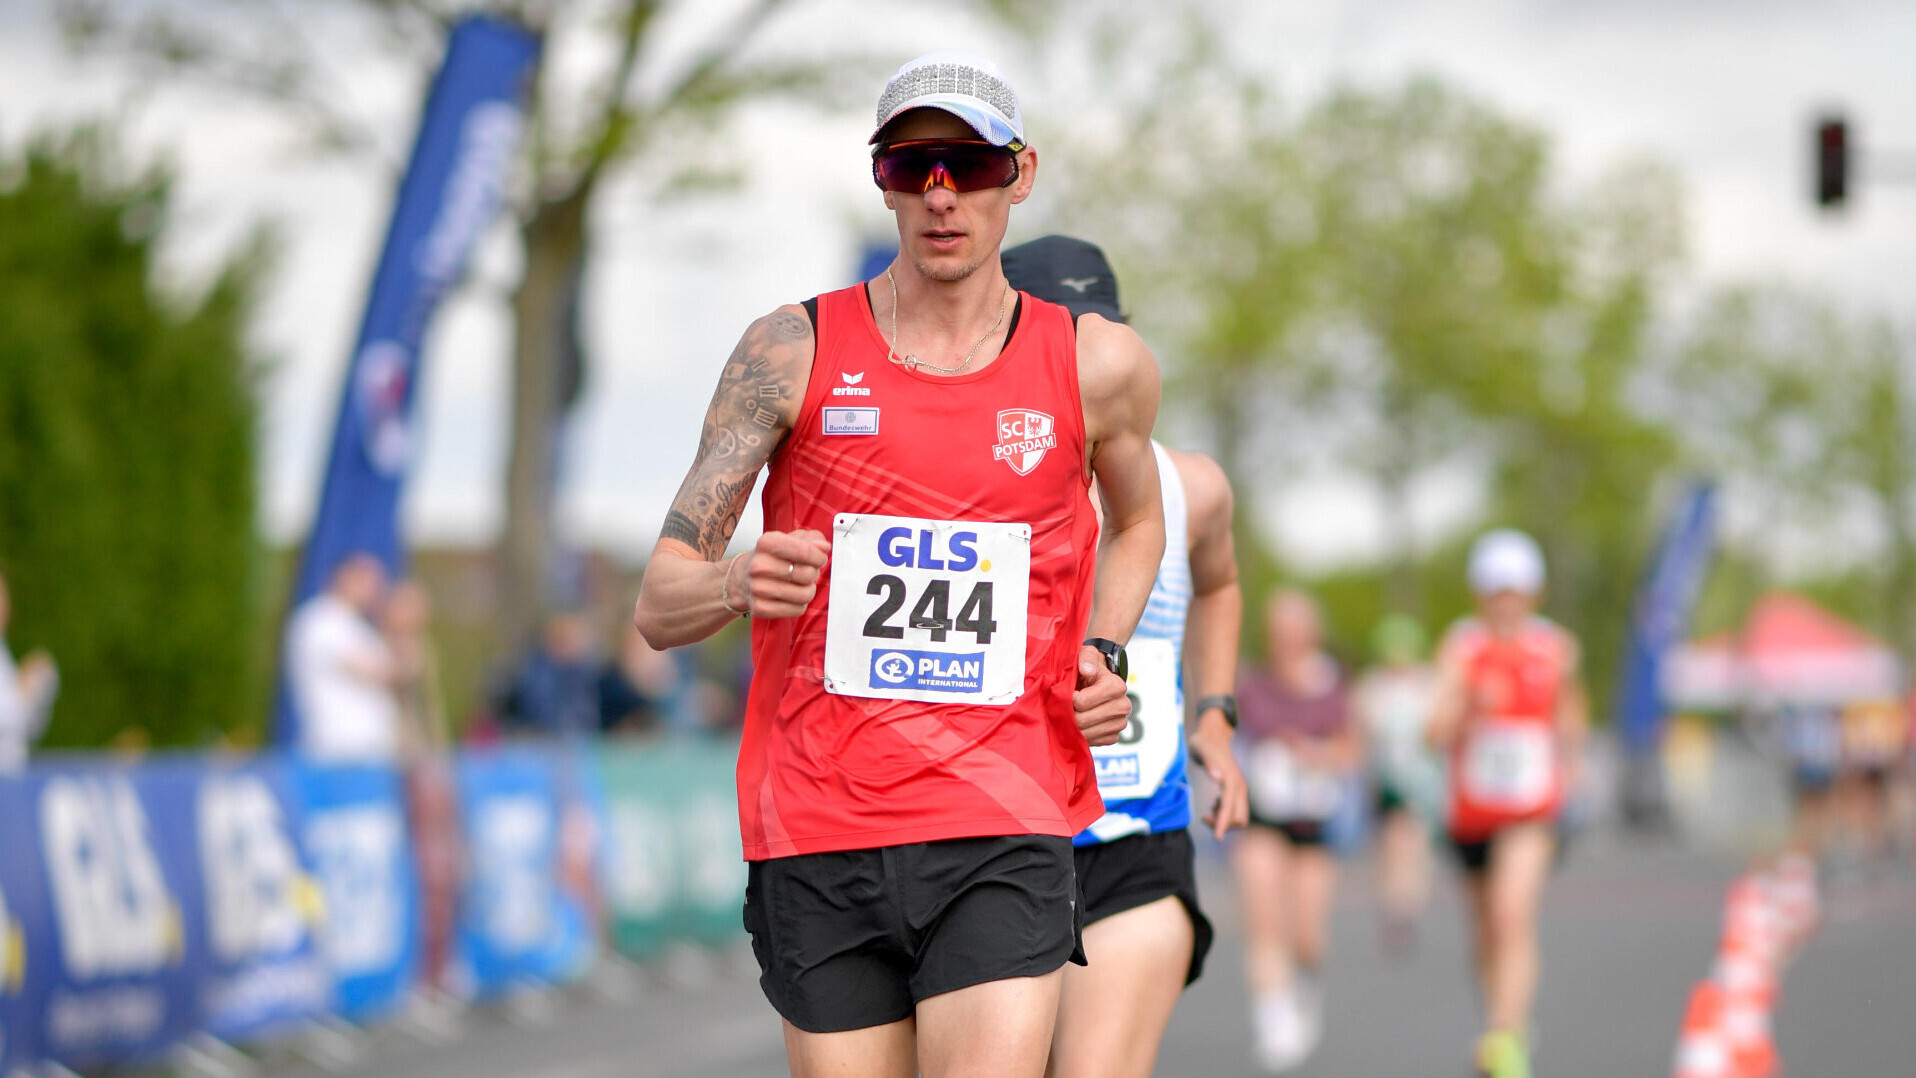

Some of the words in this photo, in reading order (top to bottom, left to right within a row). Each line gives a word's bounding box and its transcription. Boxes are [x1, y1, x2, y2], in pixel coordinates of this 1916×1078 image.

[832, 385, 871, 396] erima
[1002, 420, 1024, 440] SC
[995, 435, 1055, 458] POTSDAM
[862, 573, 998, 645] 244
[918, 658, 980, 679] PLAN
[917, 678, 979, 688] INTERNATIONAL
[1094, 757, 1137, 775] LAN
